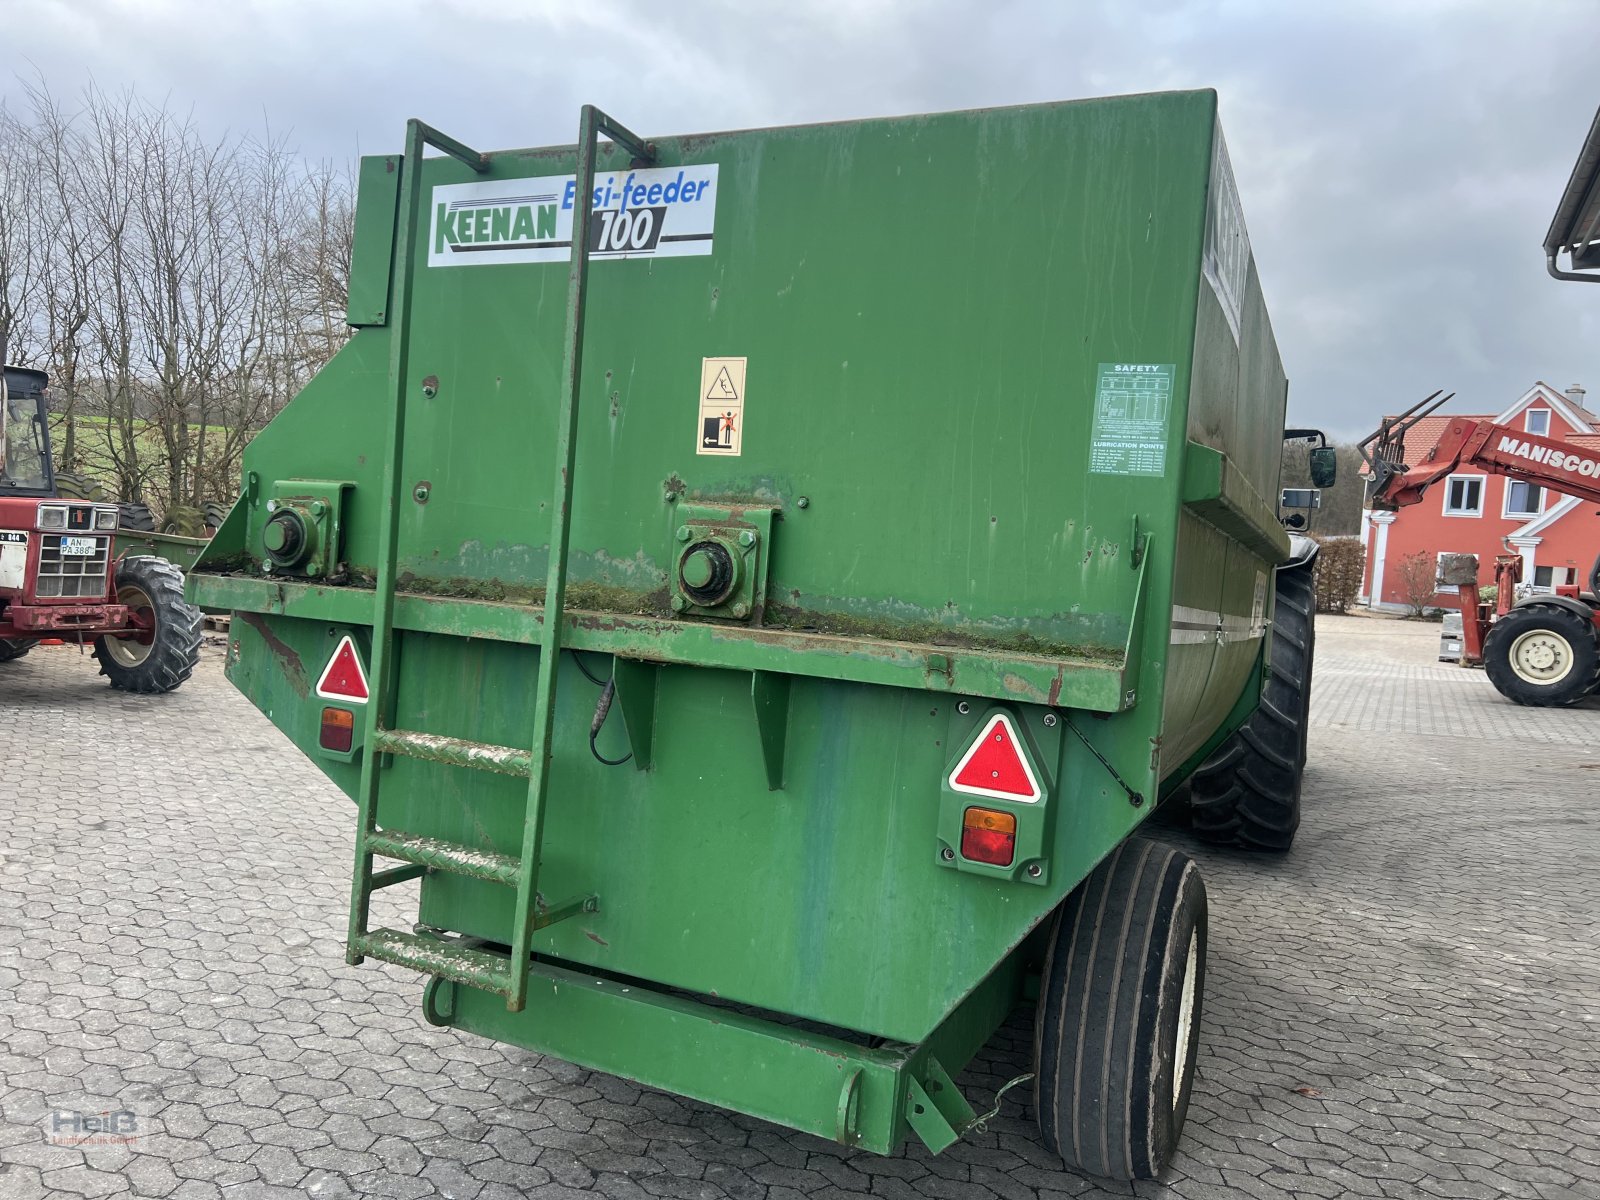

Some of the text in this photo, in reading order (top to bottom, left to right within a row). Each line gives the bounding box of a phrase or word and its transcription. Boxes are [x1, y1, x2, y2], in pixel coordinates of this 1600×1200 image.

[561, 171, 710, 215] Esi-feeder
[434, 202, 558, 255] KEENAN
[598, 208, 654, 251] 100
[1114, 364, 1160, 372] SAFETY
[1093, 441, 1138, 449] LUBRICATION
[70, 538, 82, 546] AN
